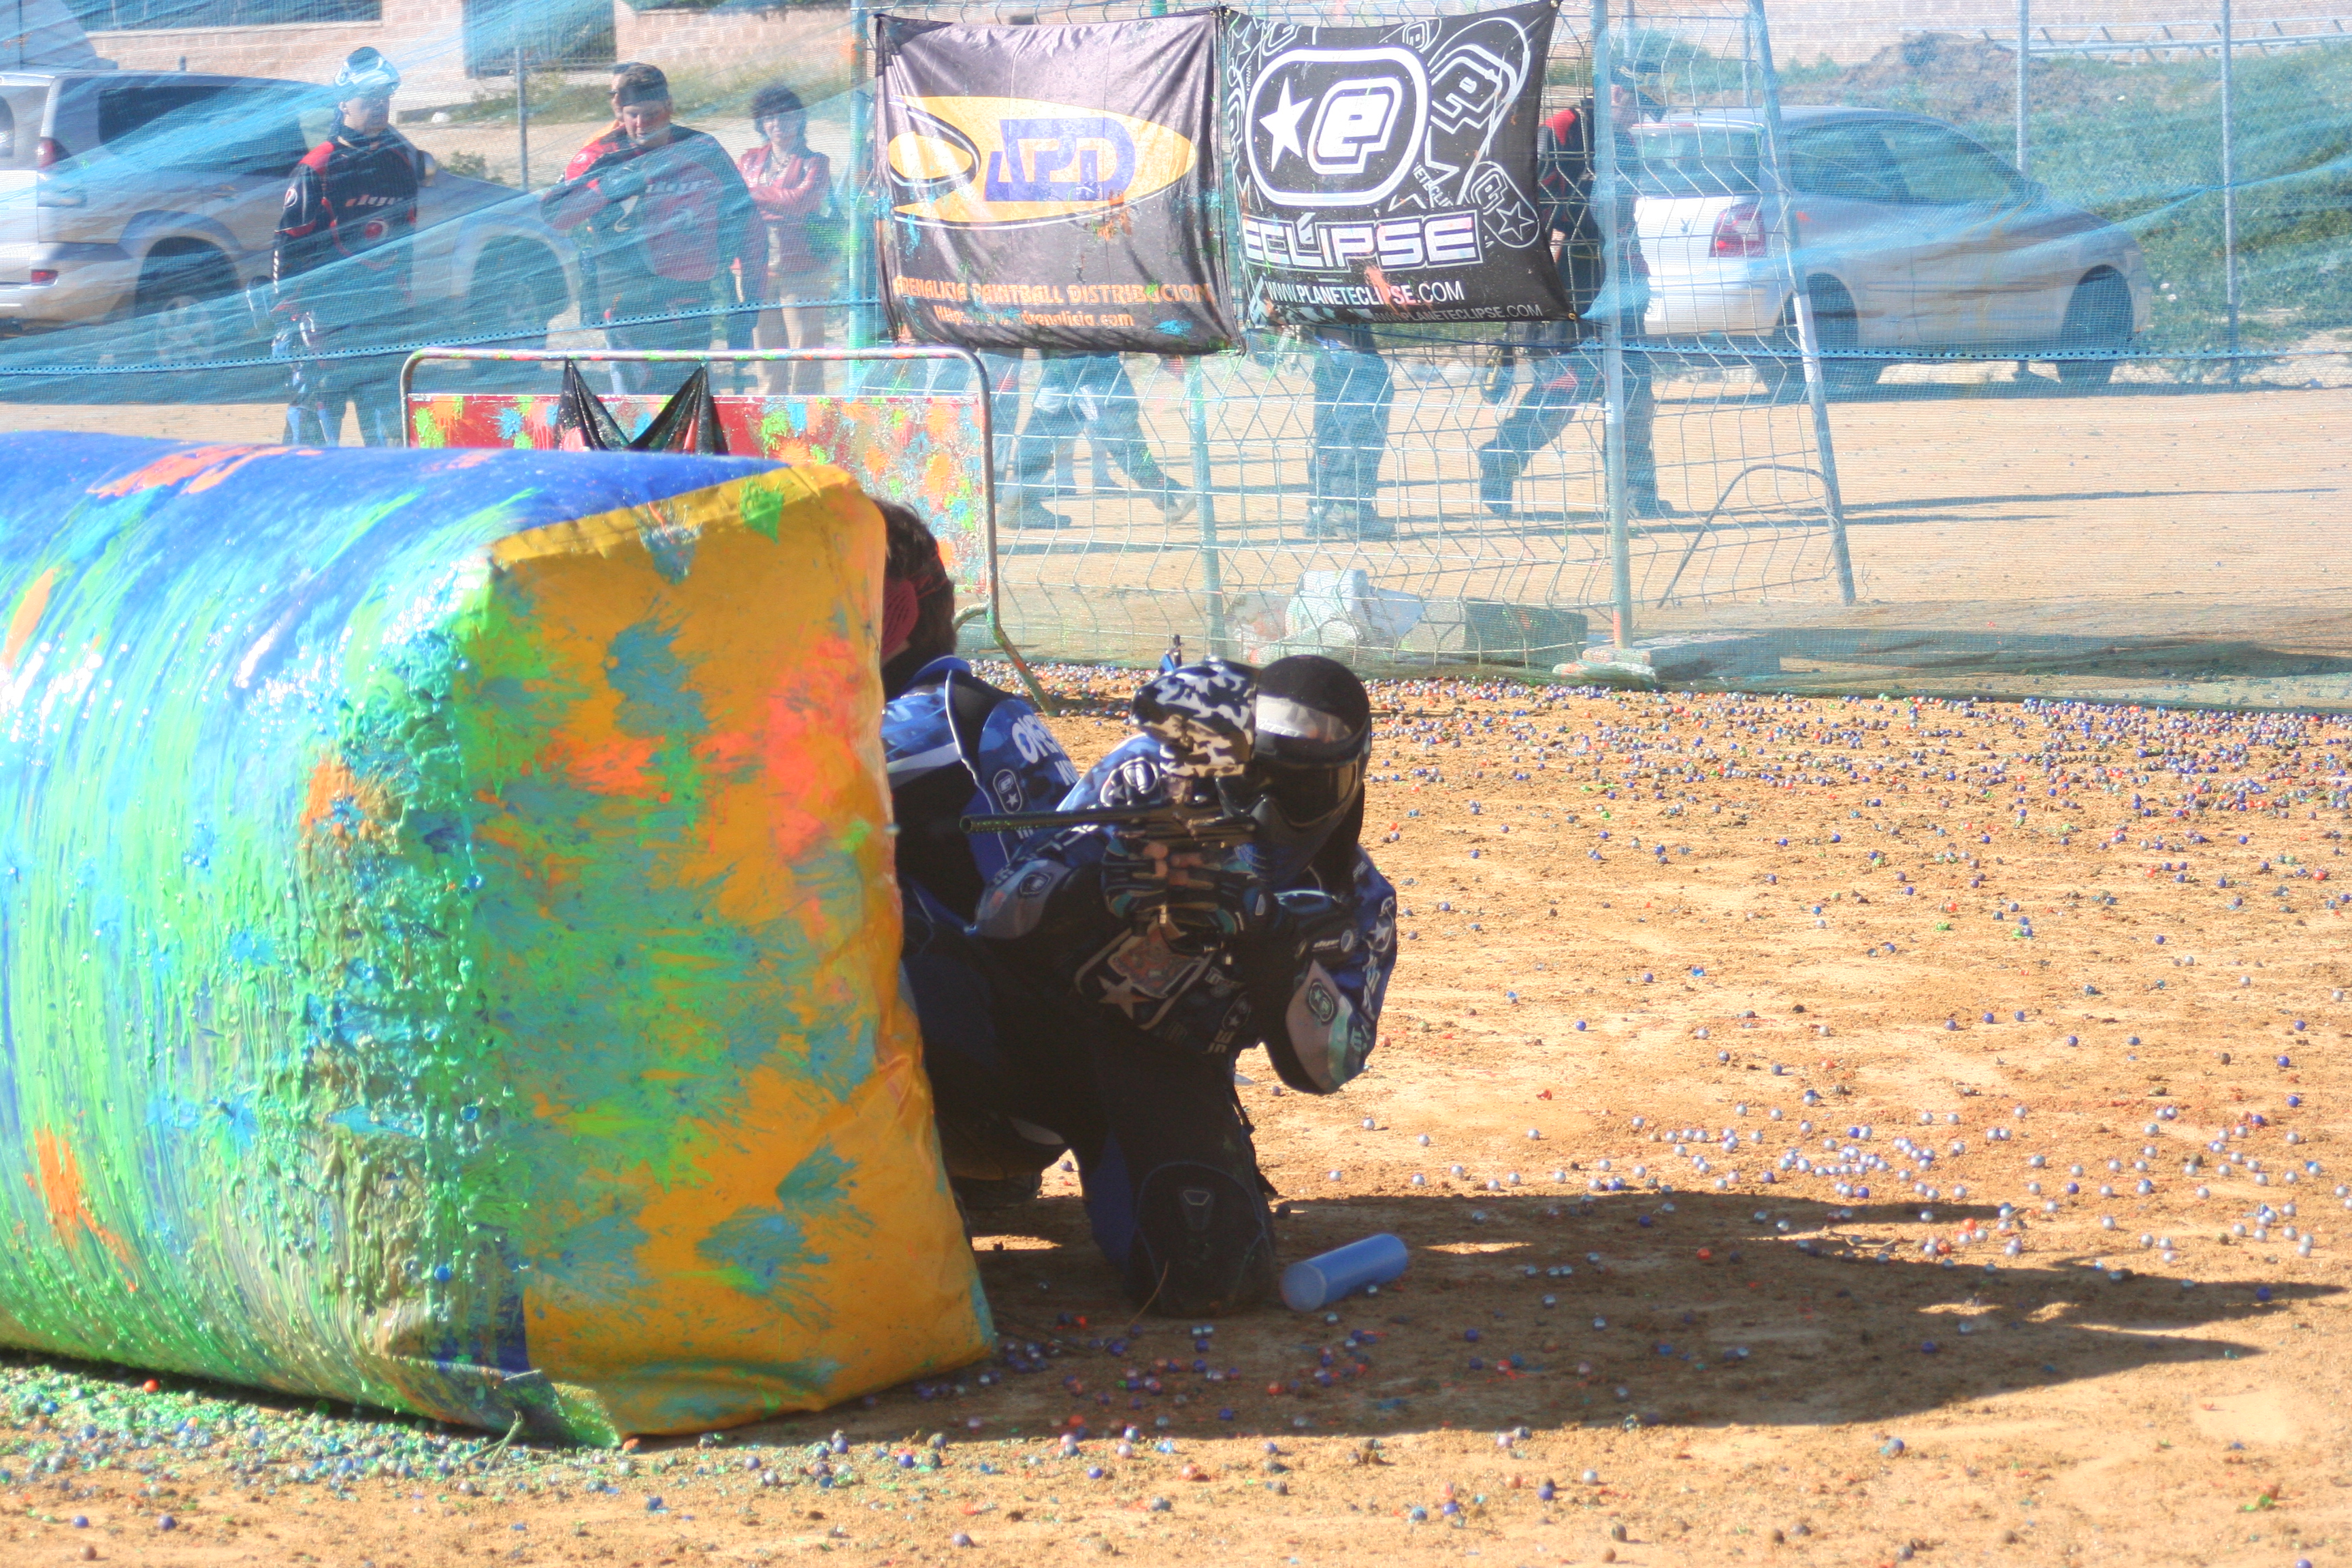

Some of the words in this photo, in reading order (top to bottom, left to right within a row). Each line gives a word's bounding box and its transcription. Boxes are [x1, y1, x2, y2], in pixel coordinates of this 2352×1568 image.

[984, 117, 1136, 202] APD
[1242, 212, 1480, 270] ECLIPSE
[971, 282, 1064, 304] PAINTBALL
[1067, 283, 1216, 304] DISTRIBUCION
